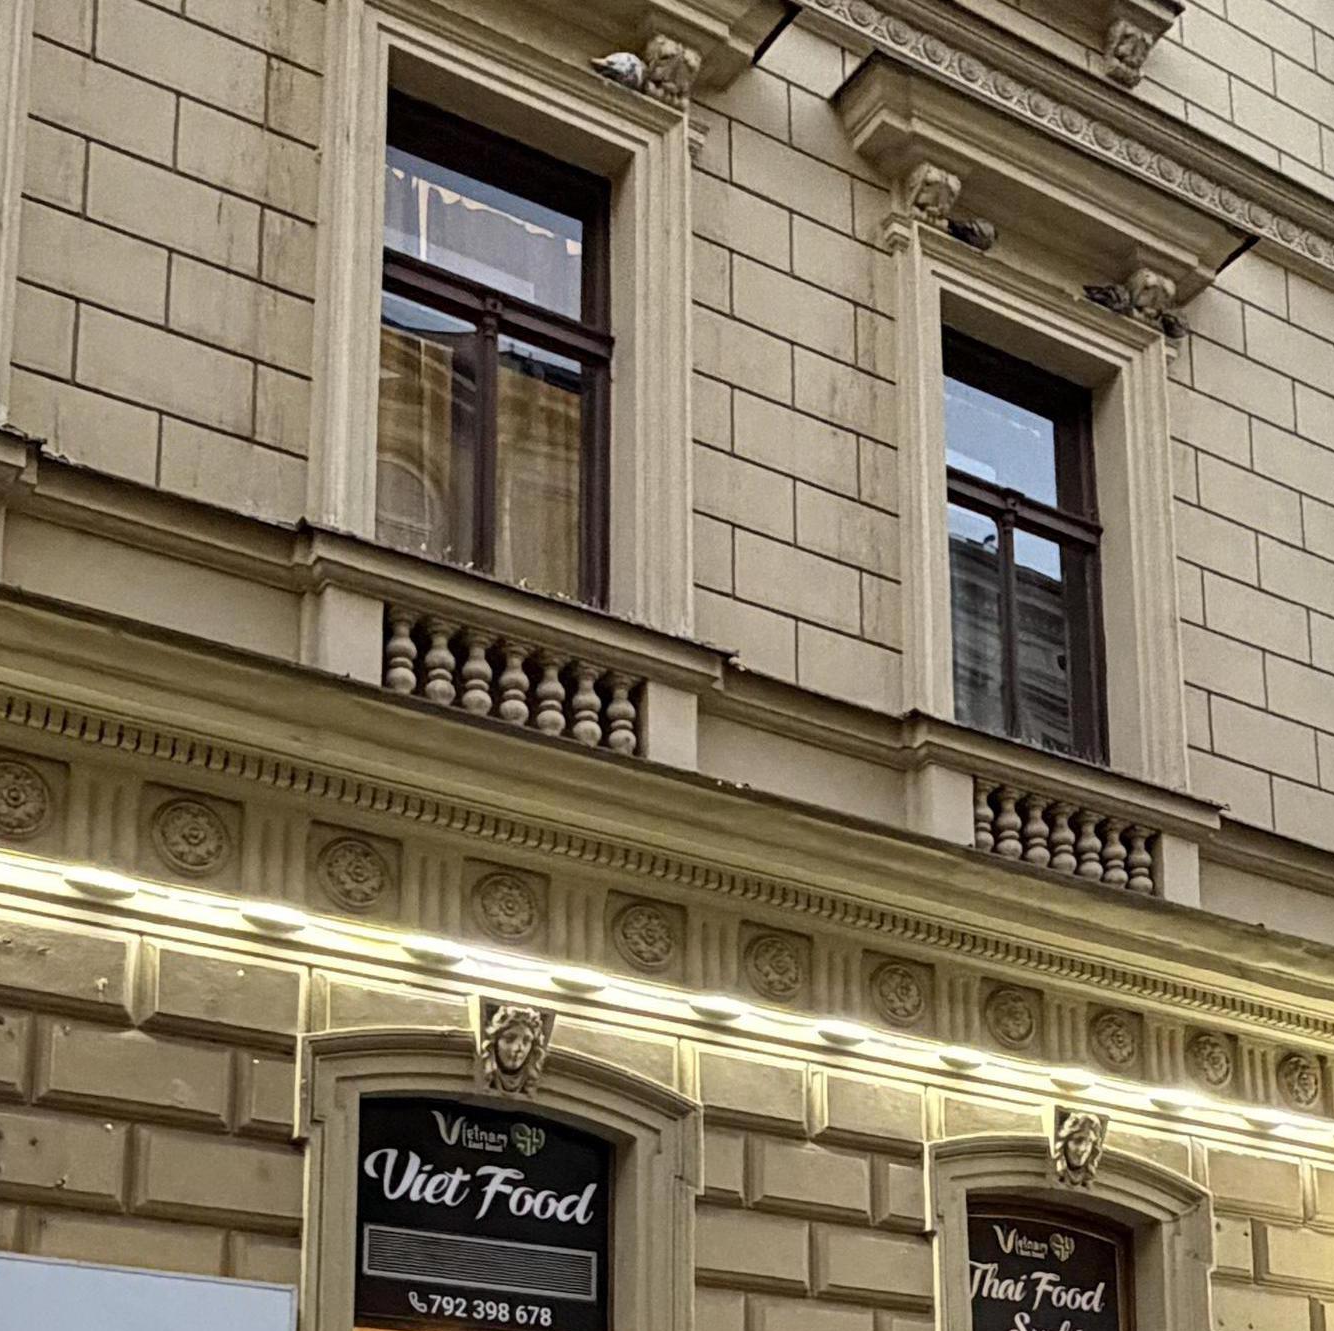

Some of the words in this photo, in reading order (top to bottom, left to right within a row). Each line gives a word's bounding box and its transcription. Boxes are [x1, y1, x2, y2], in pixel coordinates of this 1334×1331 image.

[431, 1110, 508, 1148] Vietnam
[364, 1149, 471, 1207] Viet
[475, 1165, 598, 1225] Food
[969, 1260, 1027, 1301] Thai
[1031, 1271, 1105, 1313] Food
[428, 1294, 467, 1318] 792
[473, 1300, 509, 1322] 398
[516, 1305, 552, 1327] 678
